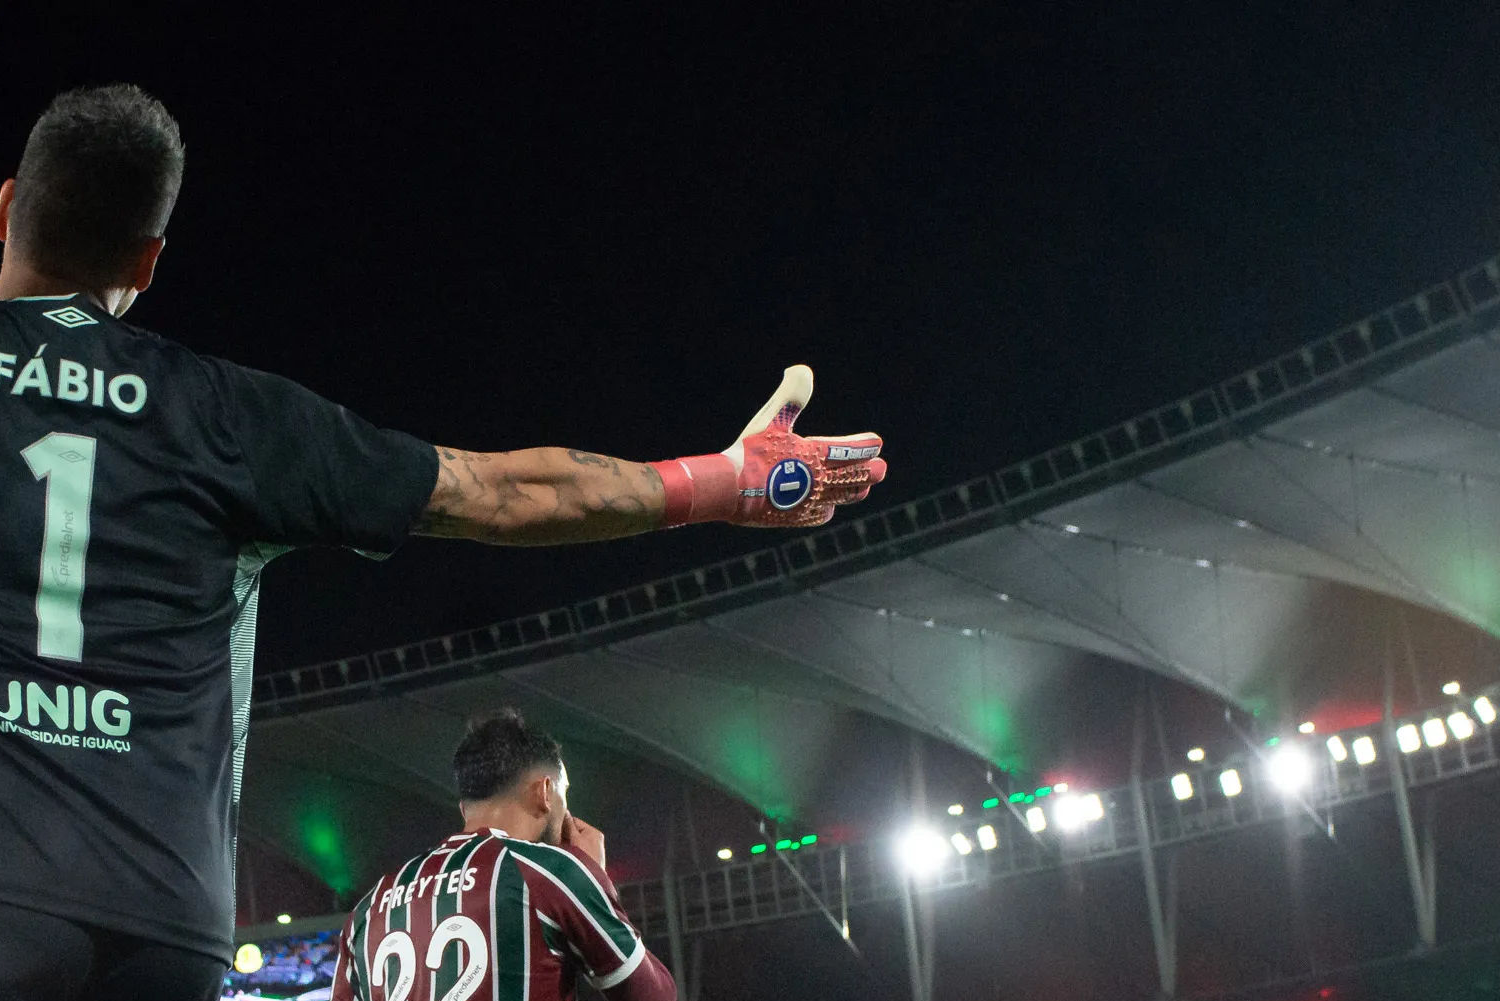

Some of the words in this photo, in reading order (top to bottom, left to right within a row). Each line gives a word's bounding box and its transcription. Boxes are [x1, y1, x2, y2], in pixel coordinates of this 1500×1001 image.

[20, 431, 97, 662] 1
[59, 509, 75, 577] predialnet
[82, 735, 131, 753] IGUAÇU
[378, 867, 478, 913] FREYTES
